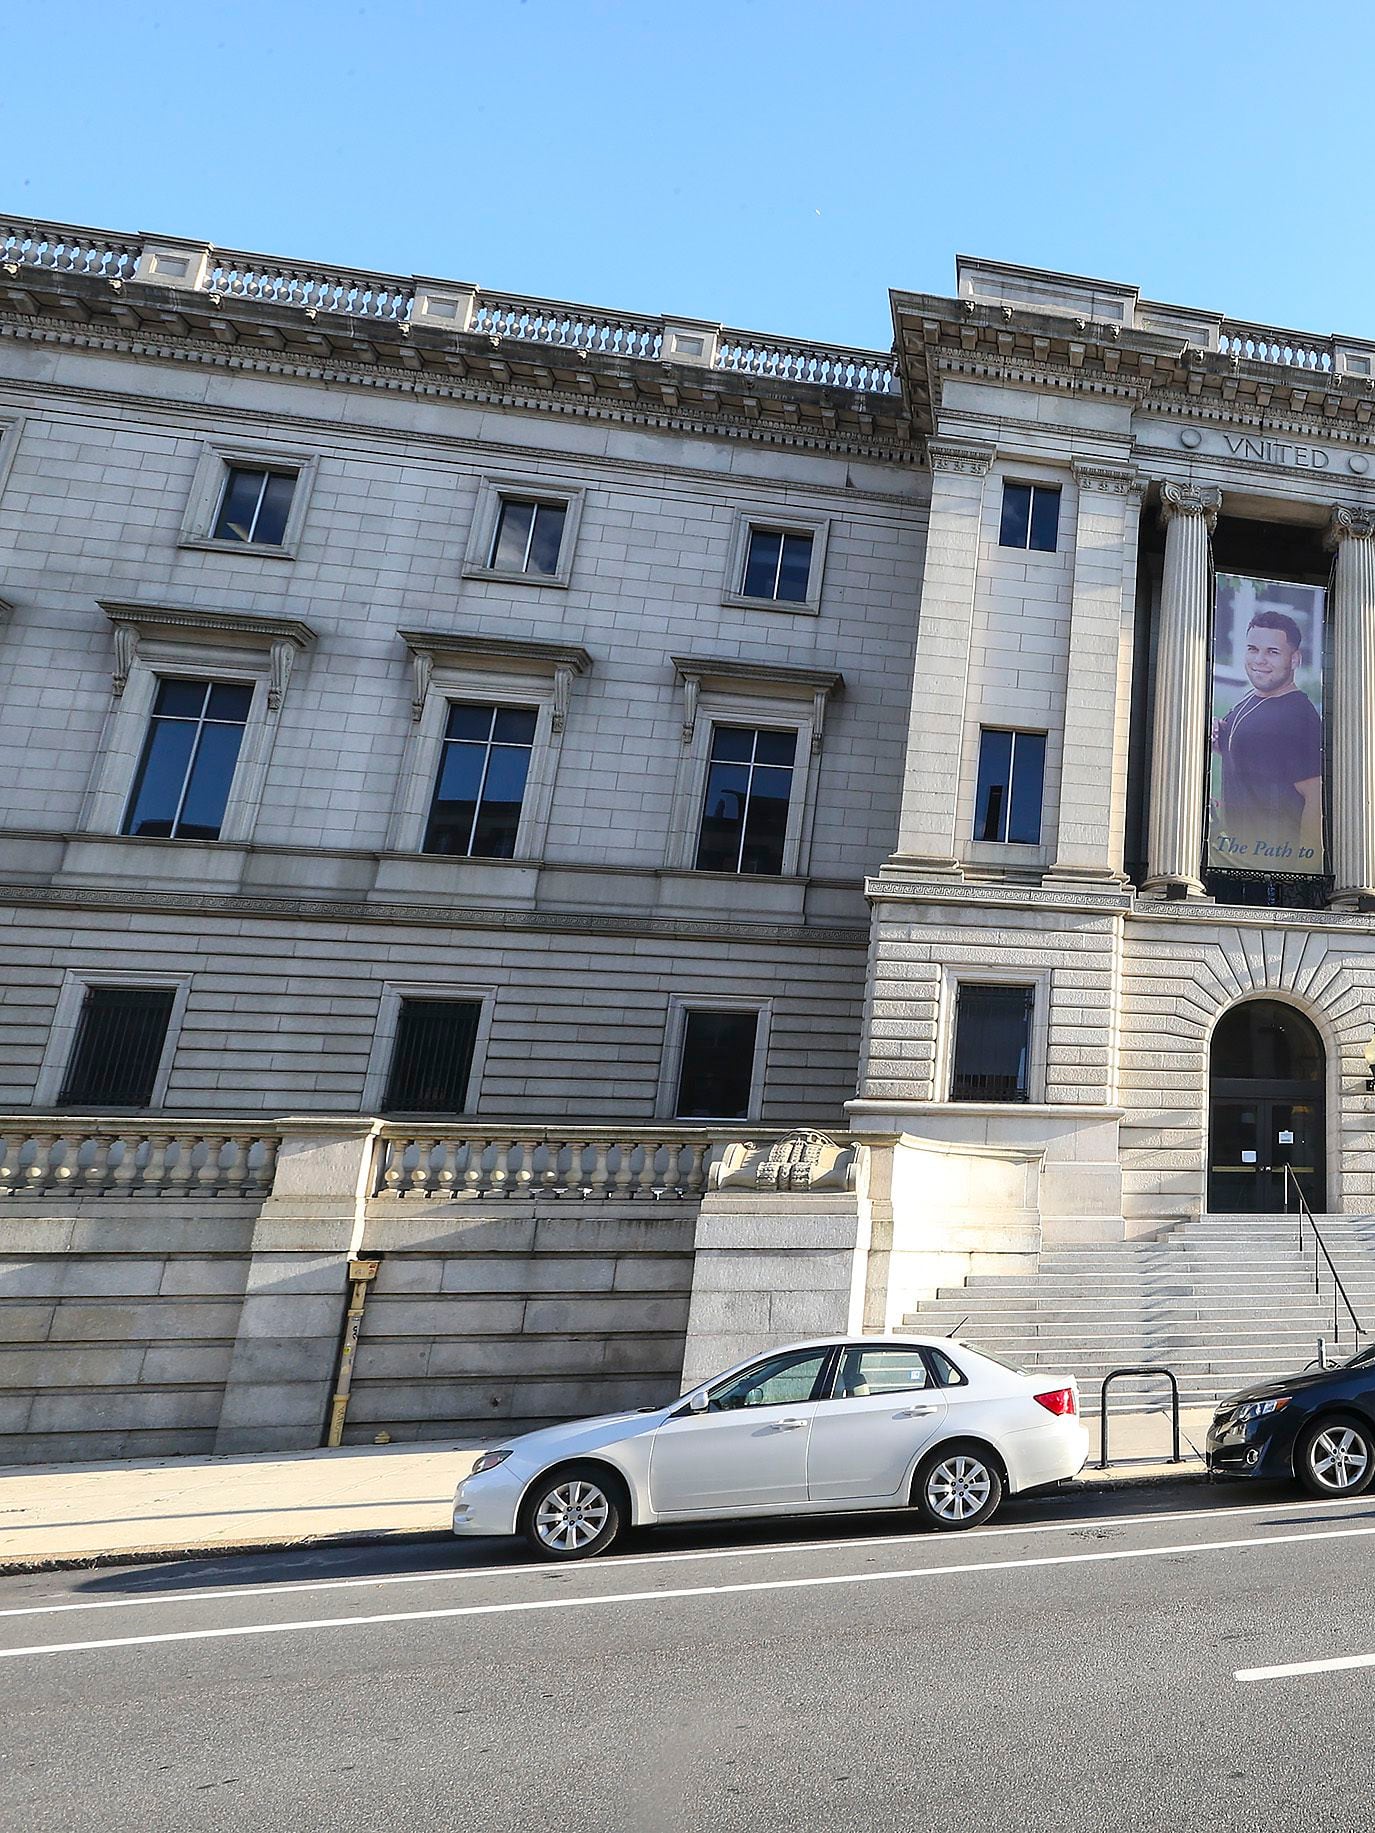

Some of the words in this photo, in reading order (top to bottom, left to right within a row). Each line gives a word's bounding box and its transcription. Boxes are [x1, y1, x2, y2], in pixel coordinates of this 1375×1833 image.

[1216, 835, 1249, 855] The
[1252, 840, 1293, 858] Path
[1298, 846, 1315, 859] to
